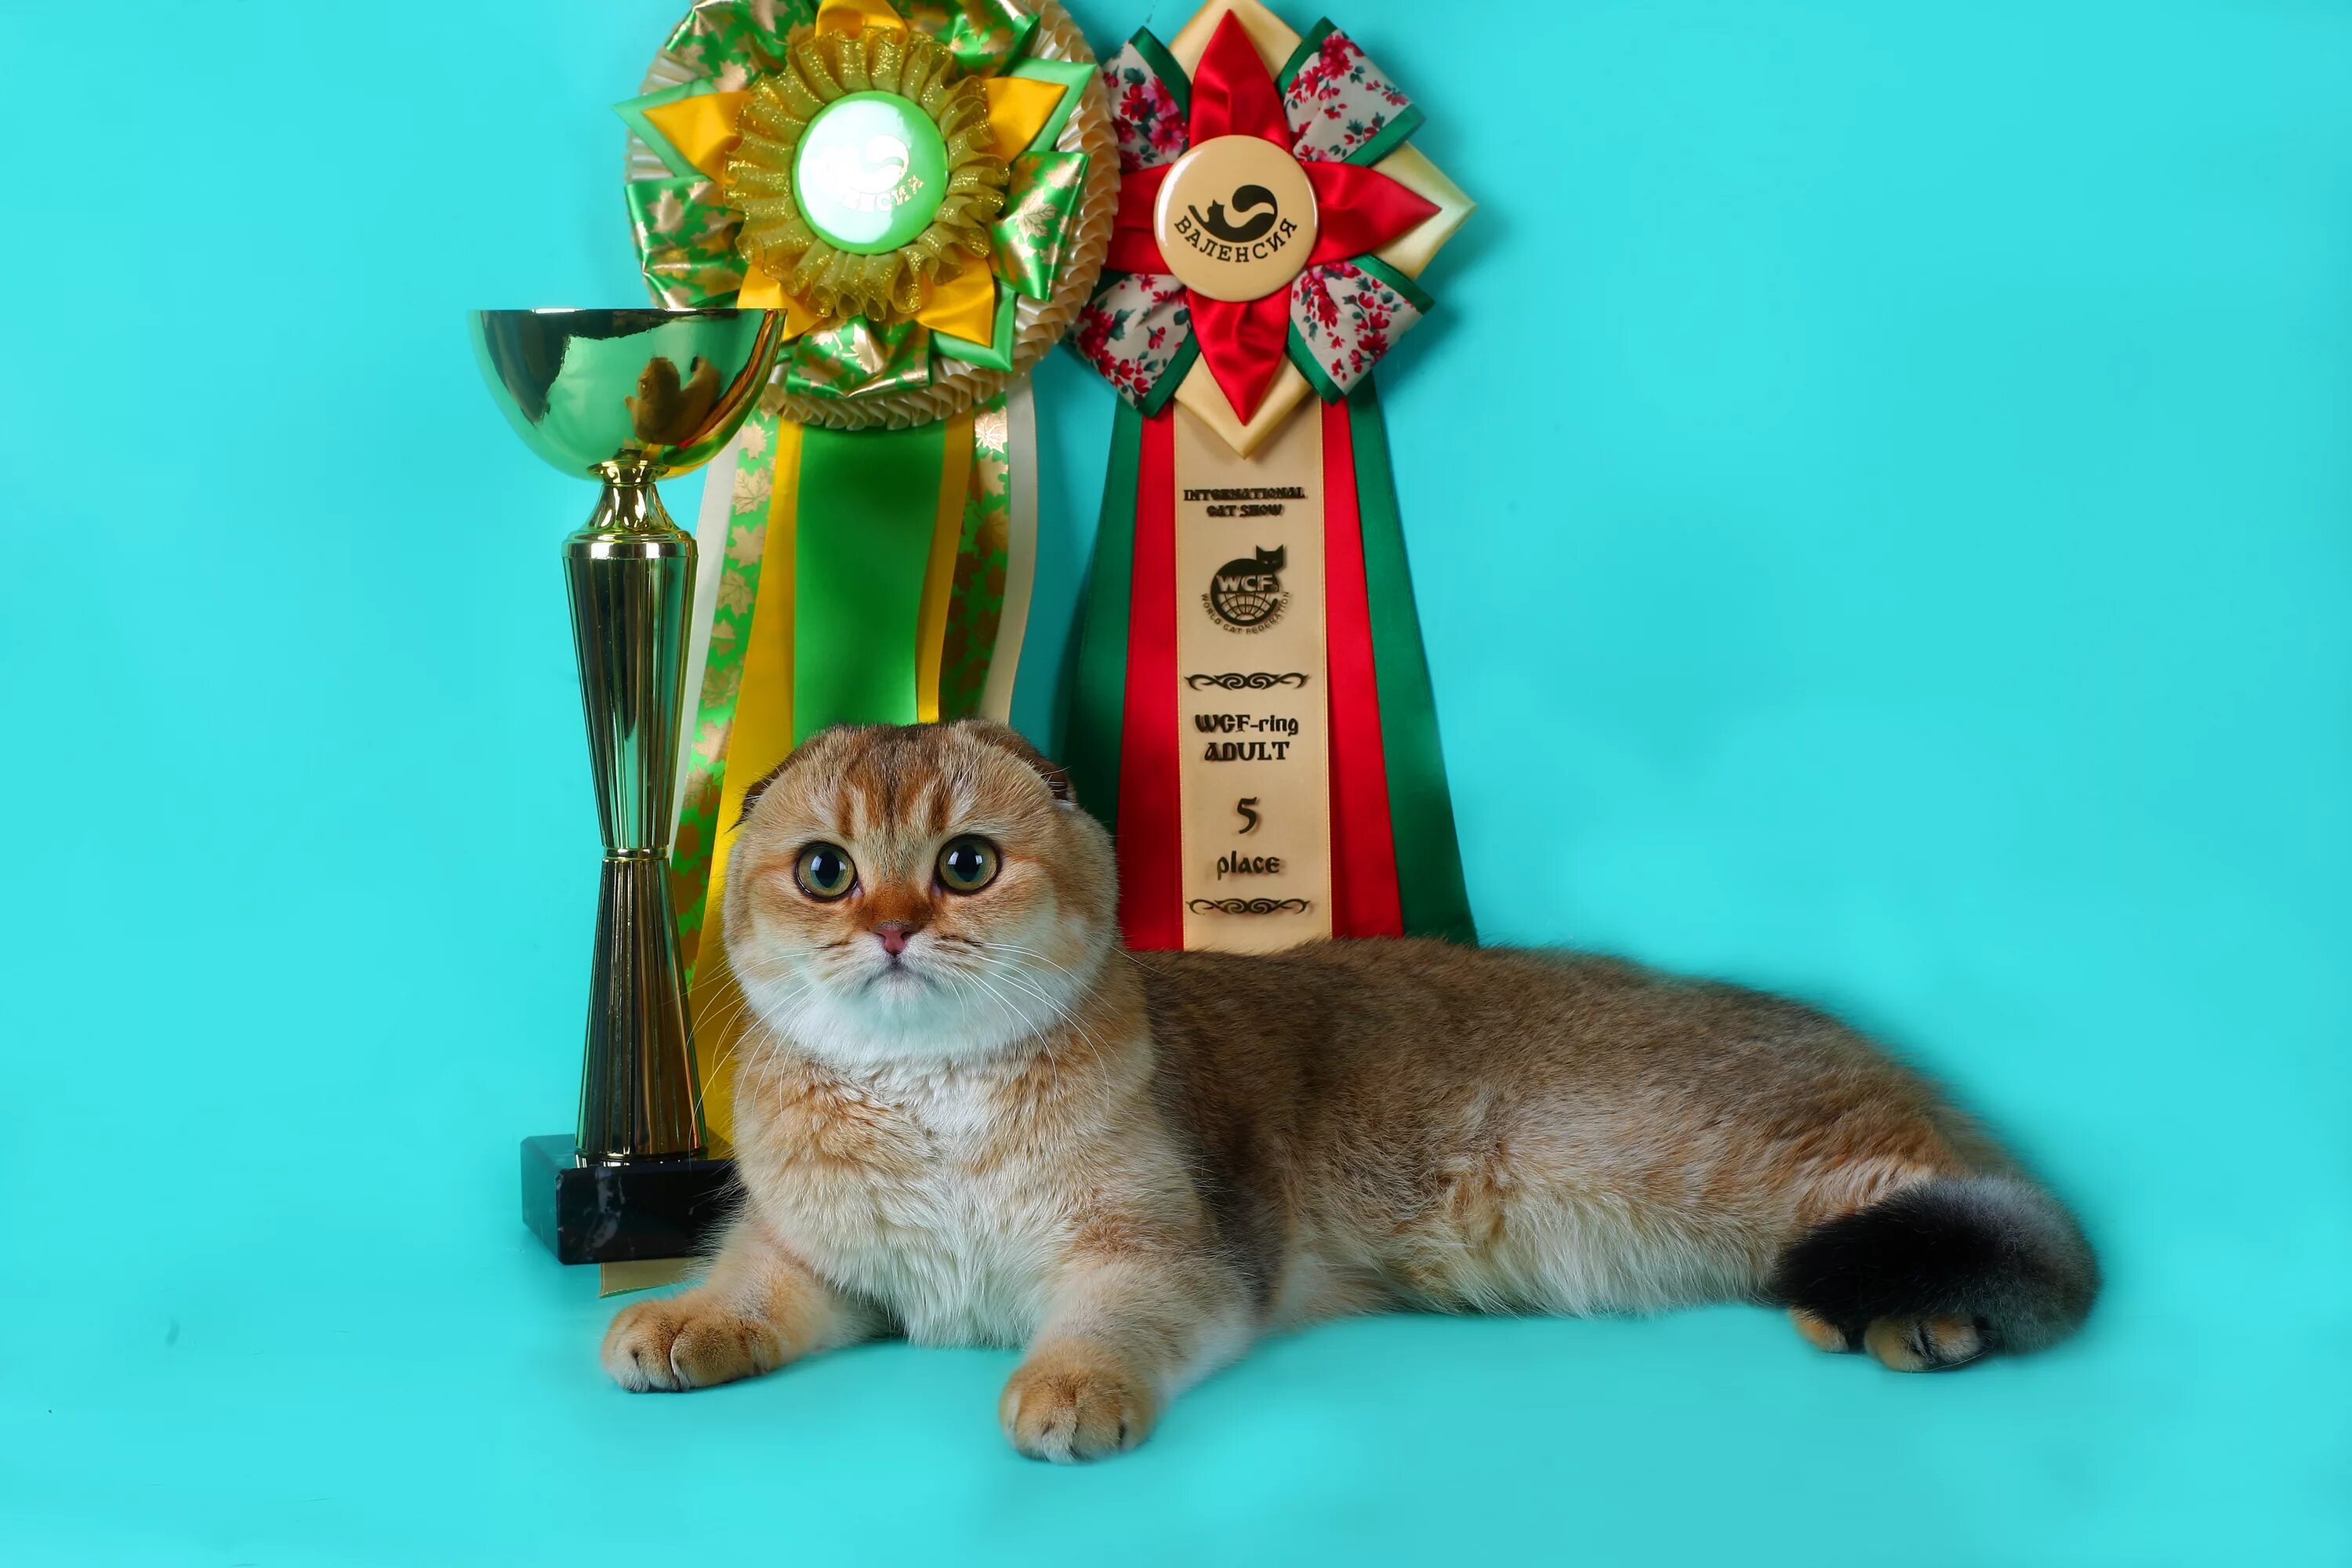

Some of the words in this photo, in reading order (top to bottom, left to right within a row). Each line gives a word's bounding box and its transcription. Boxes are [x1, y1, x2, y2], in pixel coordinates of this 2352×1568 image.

[1174, 216, 1298, 263] ВАЛЕНСИЯ
[1206, 505, 1237, 517] CAT
[1240, 504, 1283, 517] SHOW
[1216, 574, 1274, 592] WCF
[1200, 593, 1222, 625] WORLD
[1222, 623, 1243, 634] CAT
[1245, 591, 1290, 634] FEDERATION
[1194, 713, 1300, 737] WCF-ring
[1203, 741, 1290, 762] ADULT
[1236, 797, 1259, 834] 5
[1216, 850, 1281, 880] place
